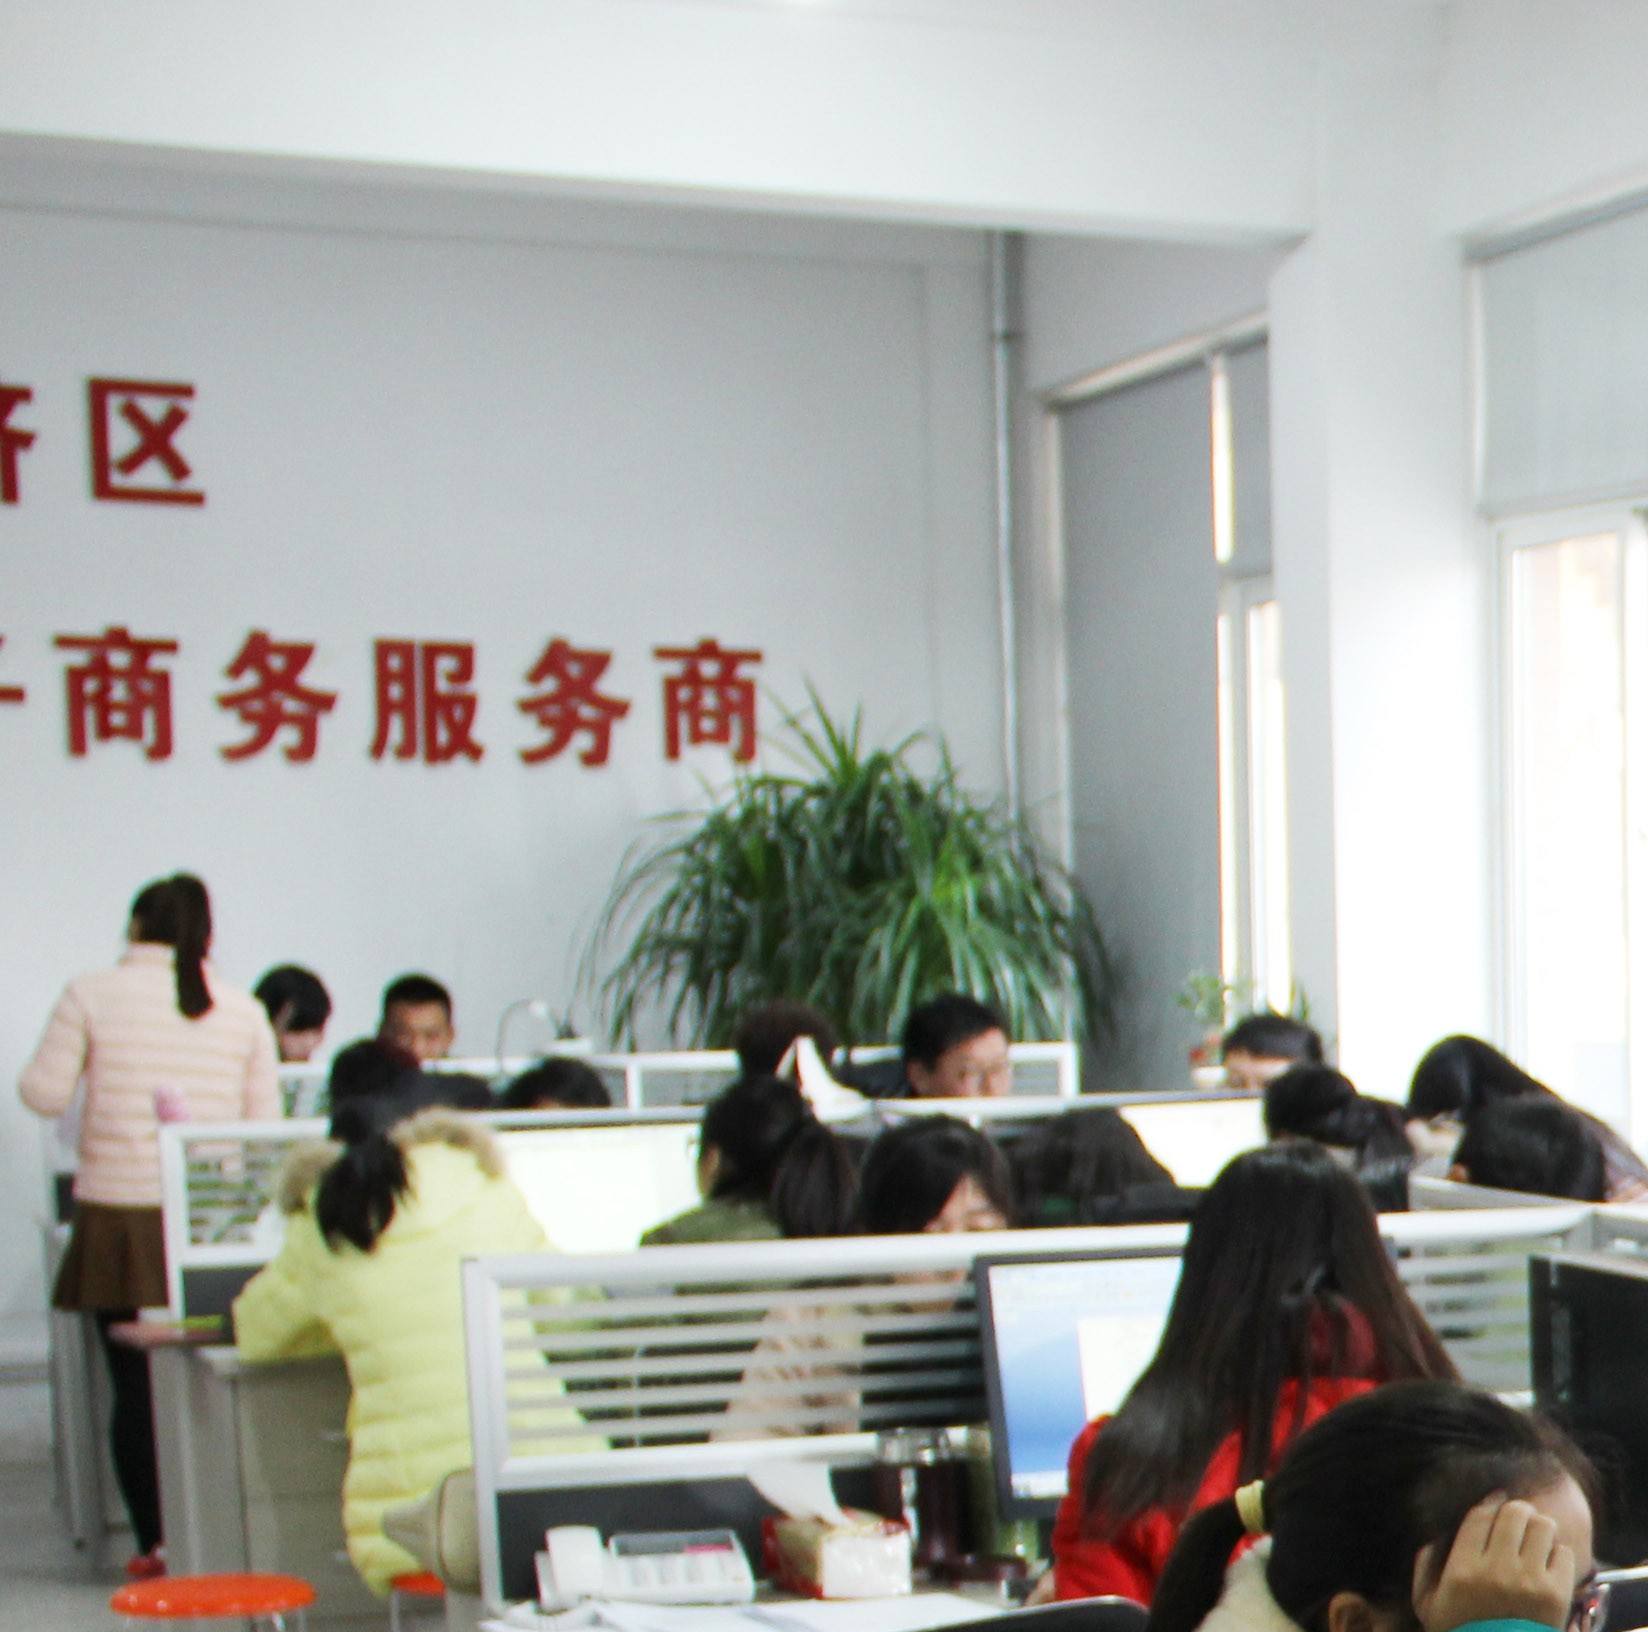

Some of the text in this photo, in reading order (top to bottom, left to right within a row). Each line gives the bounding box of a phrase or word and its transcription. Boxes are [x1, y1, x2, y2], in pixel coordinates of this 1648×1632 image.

[0, 625, 764, 767] 商务服务商
